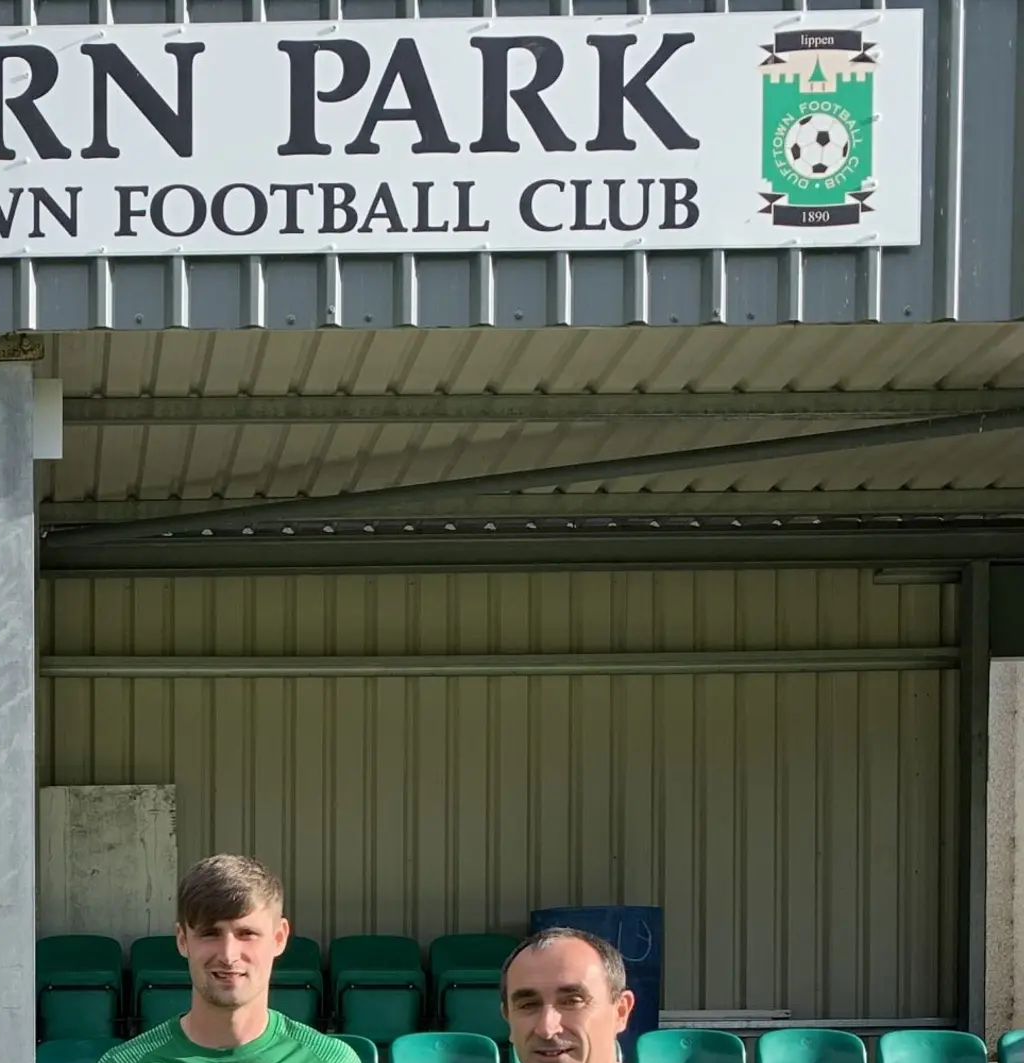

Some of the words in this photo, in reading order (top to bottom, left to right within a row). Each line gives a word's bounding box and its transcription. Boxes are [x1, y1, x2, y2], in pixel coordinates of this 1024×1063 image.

[801, 34, 834, 48] lippen
[278, 33, 699, 155] PARK
[799, 101, 863, 148] FOOTBALL
[772, 113, 809, 189] DUFFTOWN
[825, 156, 859, 189] CLUB
[115, 182, 489, 236] FOOTBALL
[520, 179, 699, 231] CLUB
[802, 211, 830, 223] 1890
